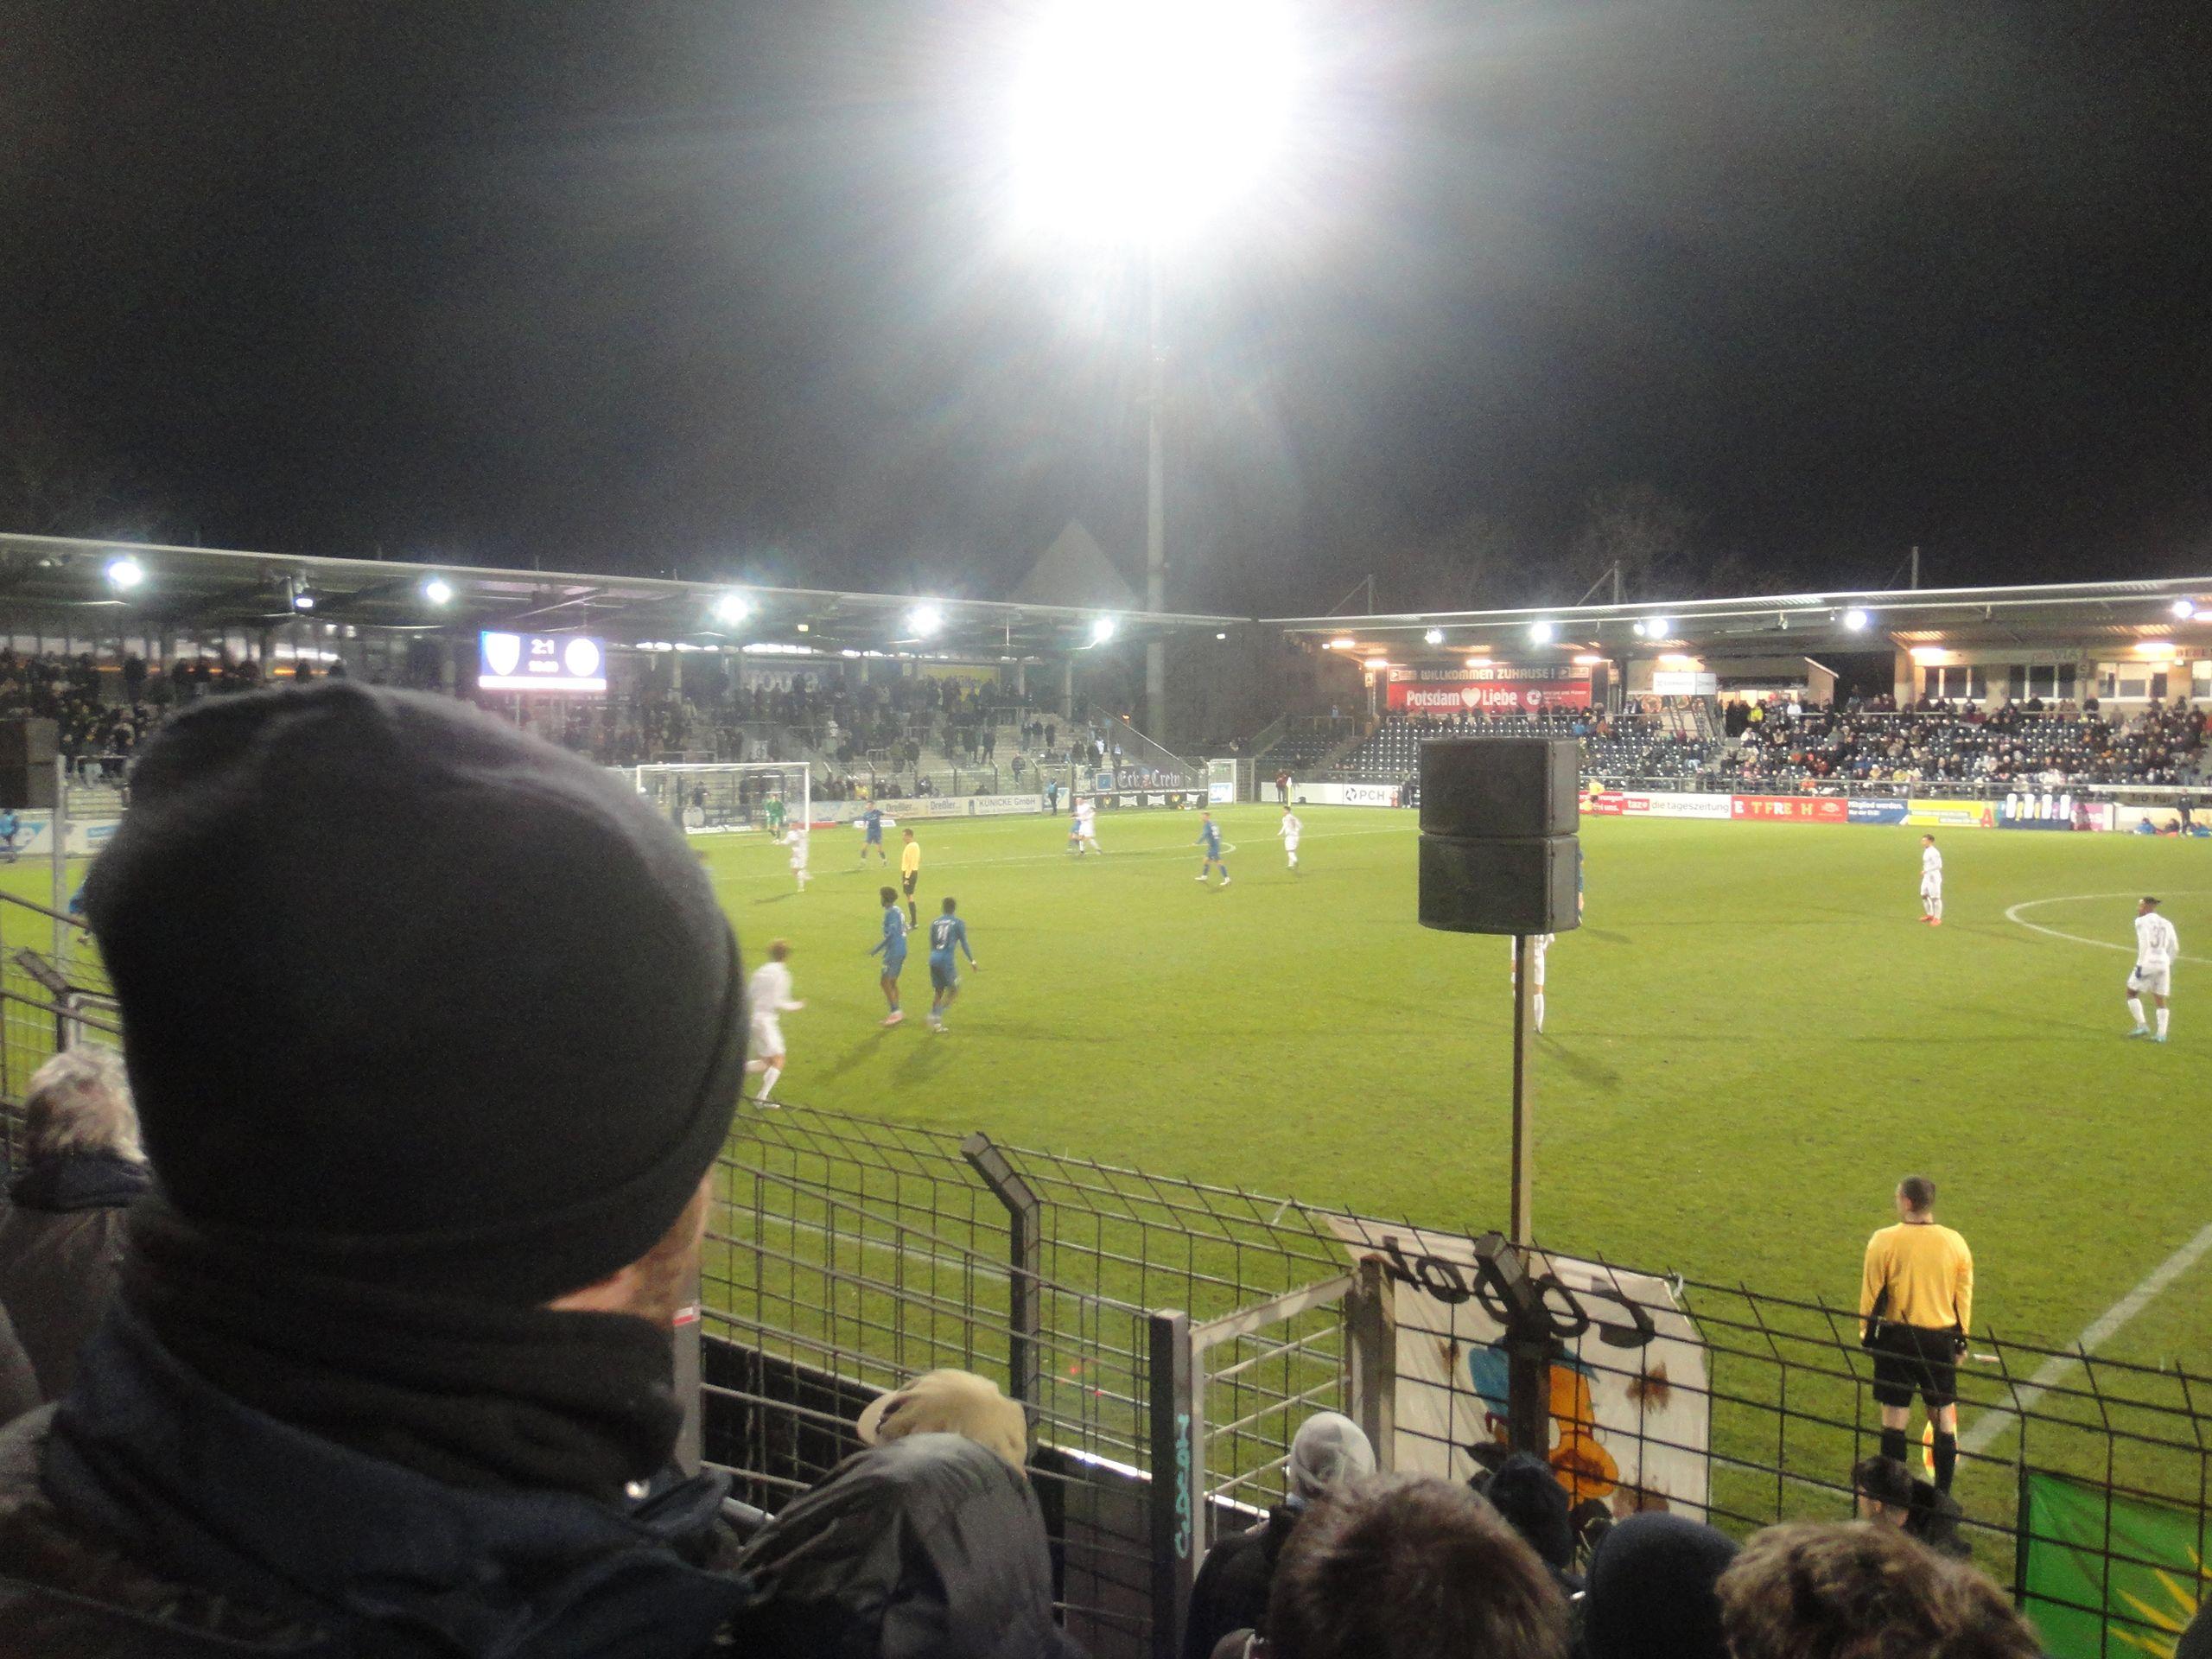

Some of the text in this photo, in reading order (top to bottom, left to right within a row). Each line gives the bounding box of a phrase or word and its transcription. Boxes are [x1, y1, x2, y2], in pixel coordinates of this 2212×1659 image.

[1406, 689, 1517, 706] Potsdam Liebe
[1358, 789, 1385, 801] PCH
[1651, 801, 1729, 813] die tageszeitung
